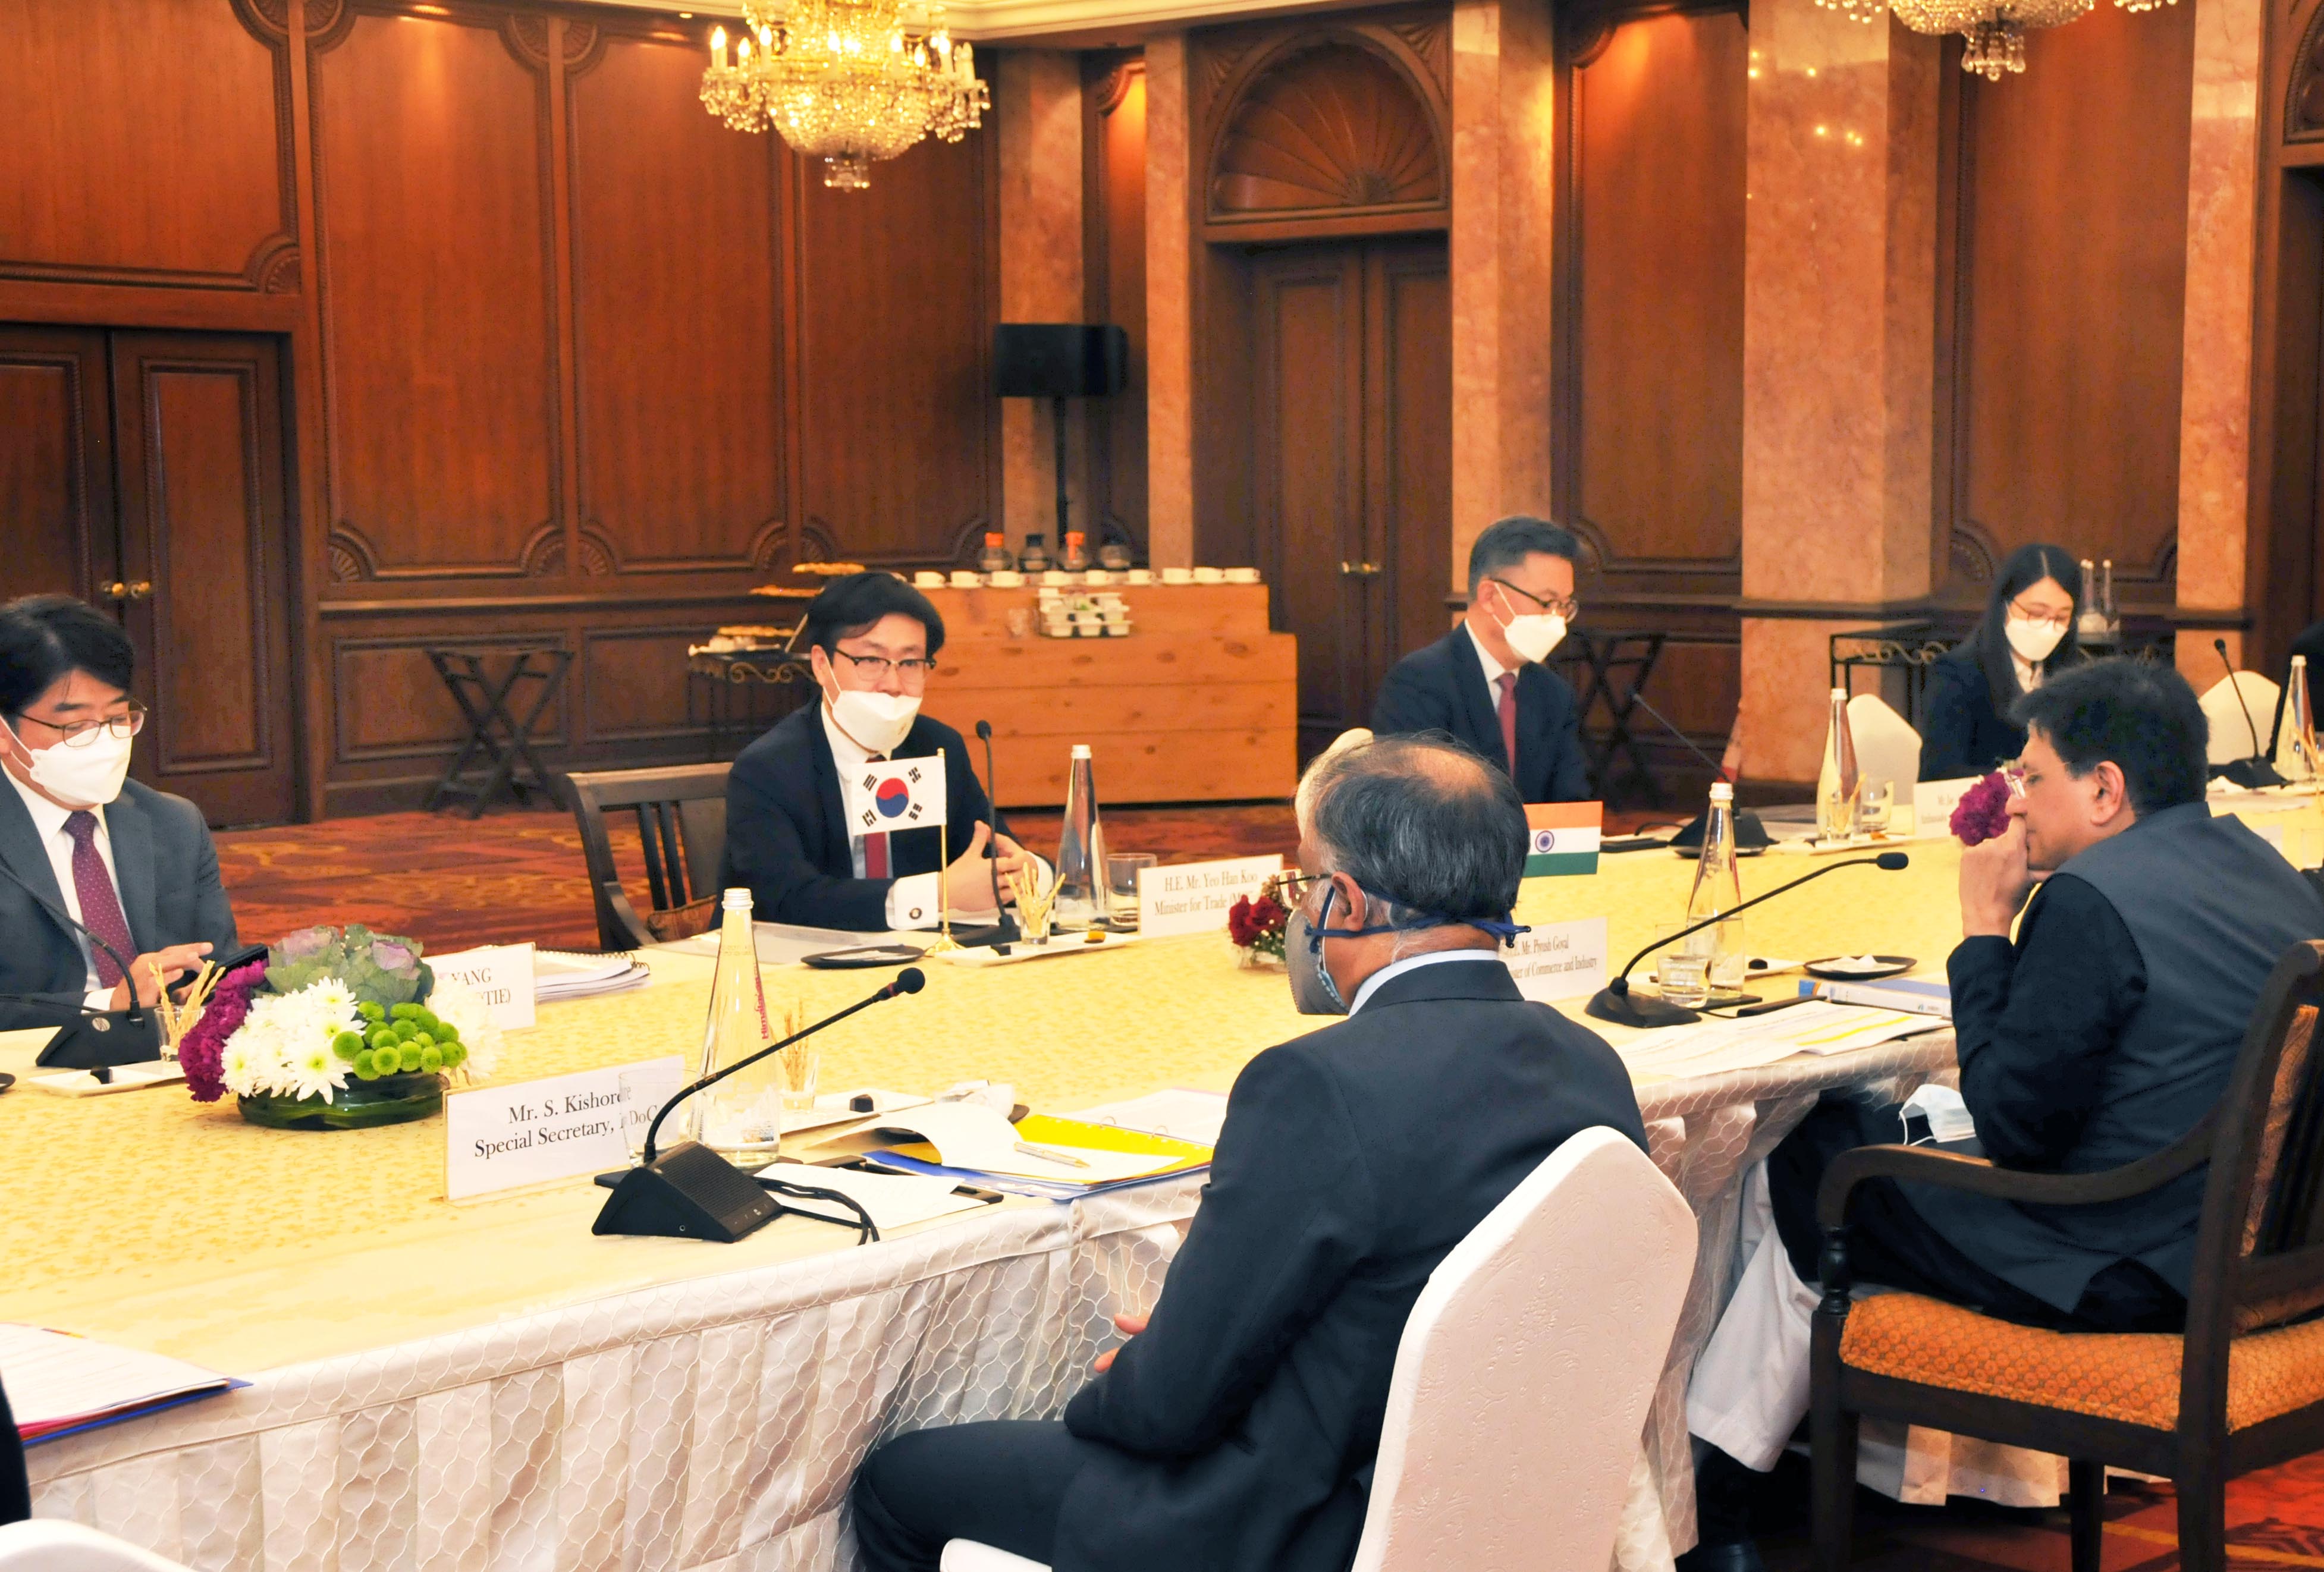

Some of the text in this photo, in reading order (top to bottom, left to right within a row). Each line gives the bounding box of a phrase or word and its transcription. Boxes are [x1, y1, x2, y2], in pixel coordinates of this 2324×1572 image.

[1164, 876, 1183, 892] H.E.
[1186, 875, 1201, 889] Mr.
[1221, 871, 1238, 885] Han
[1155, 898, 1188, 916] Minister
[1189, 897, 1202, 912] for
[1204, 894, 1227, 910] Trade
[1563, 955, 1574, 971] and
[476, 988, 511, 1005] TIE)
[508, 1105, 538, 1124] Mr.
[544, 1100, 558, 1118] S.
[474, 1131, 532, 1159] Special
[538, 1120, 614, 1146] Secretary,
